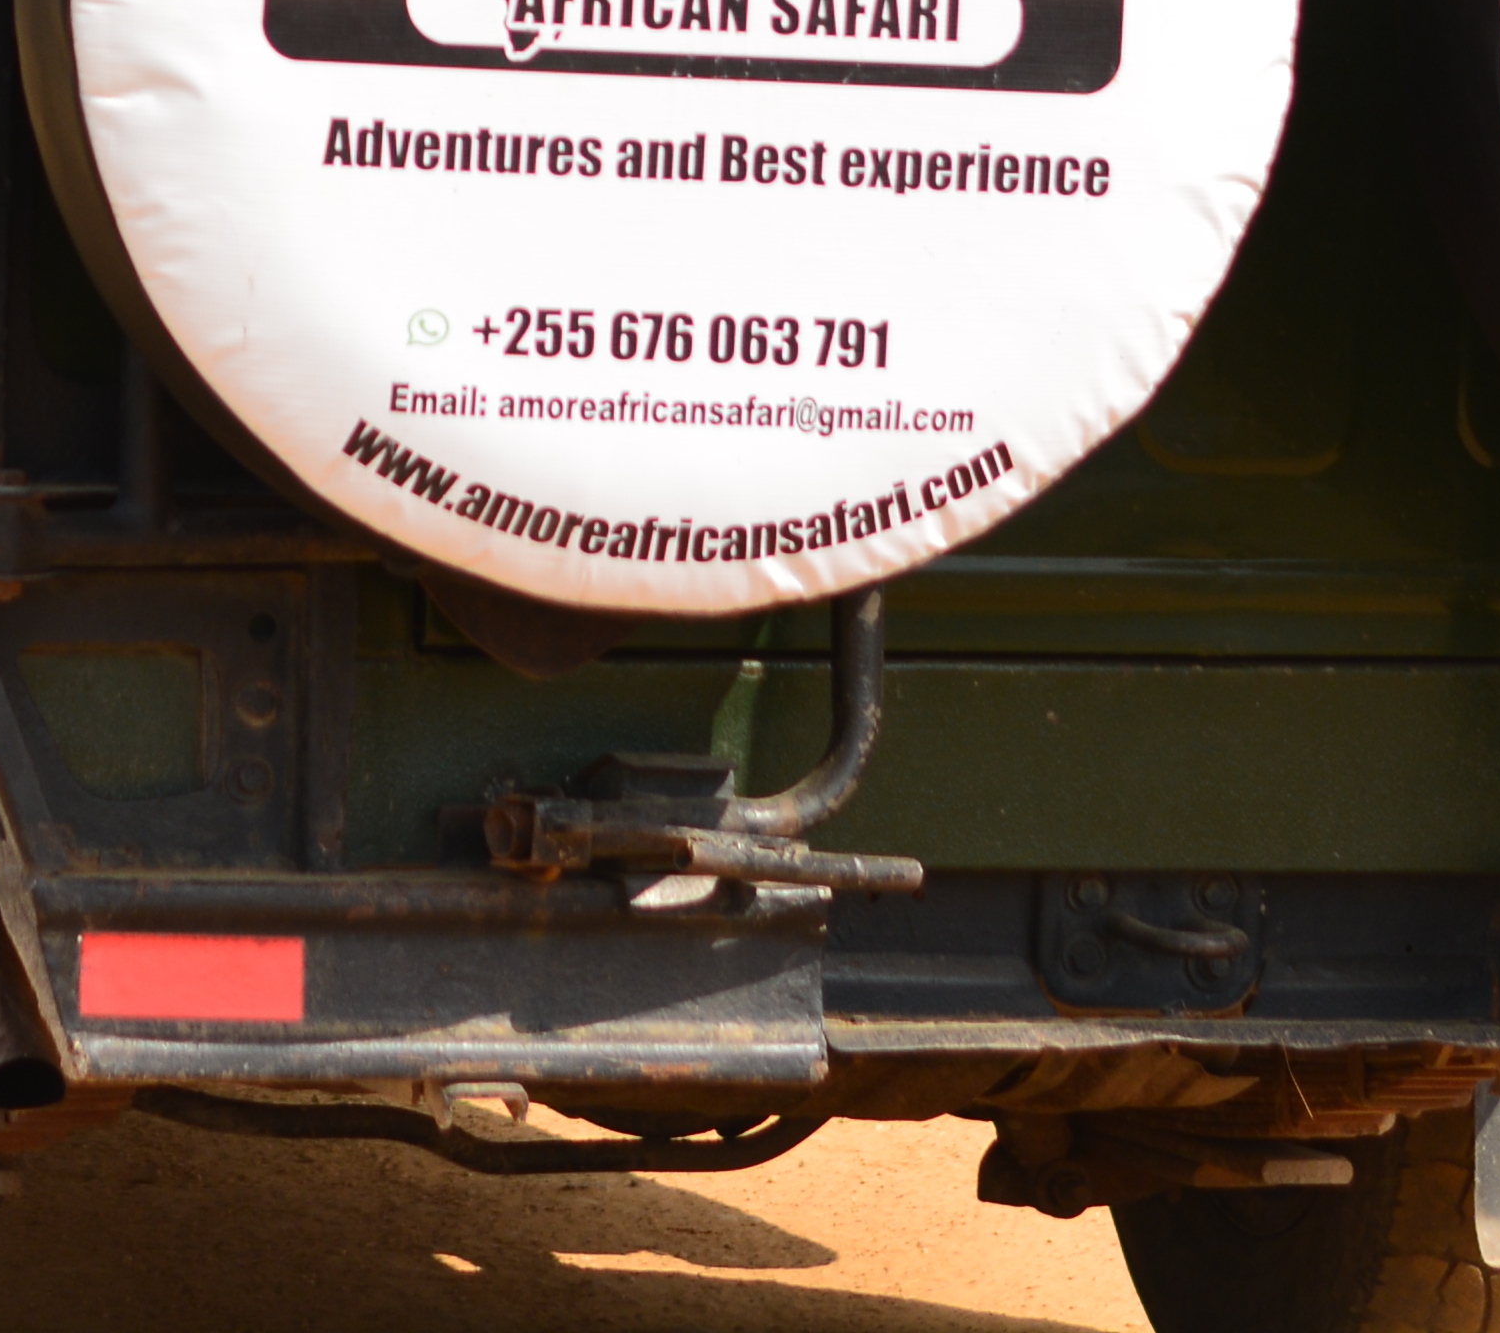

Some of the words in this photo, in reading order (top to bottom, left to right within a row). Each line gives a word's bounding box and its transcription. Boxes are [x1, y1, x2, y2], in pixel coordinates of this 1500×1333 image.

[322, 117, 603, 178] Adventures
[616, 133, 707, 182] and
[719, 134, 828, 187] Best
[839, 144, 1111, 198] experience
[472, 307, 596, 360] +255
[610, 311, 695, 363] 676
[708, 314, 801, 367] 063
[814, 318, 889, 369] 791
[389, 383, 486, 418] Email:
[498, 392, 975, 438] amoreafricansafari@gmail.com
[341, 418, 1015, 565] www.amoreafricansafari.com
